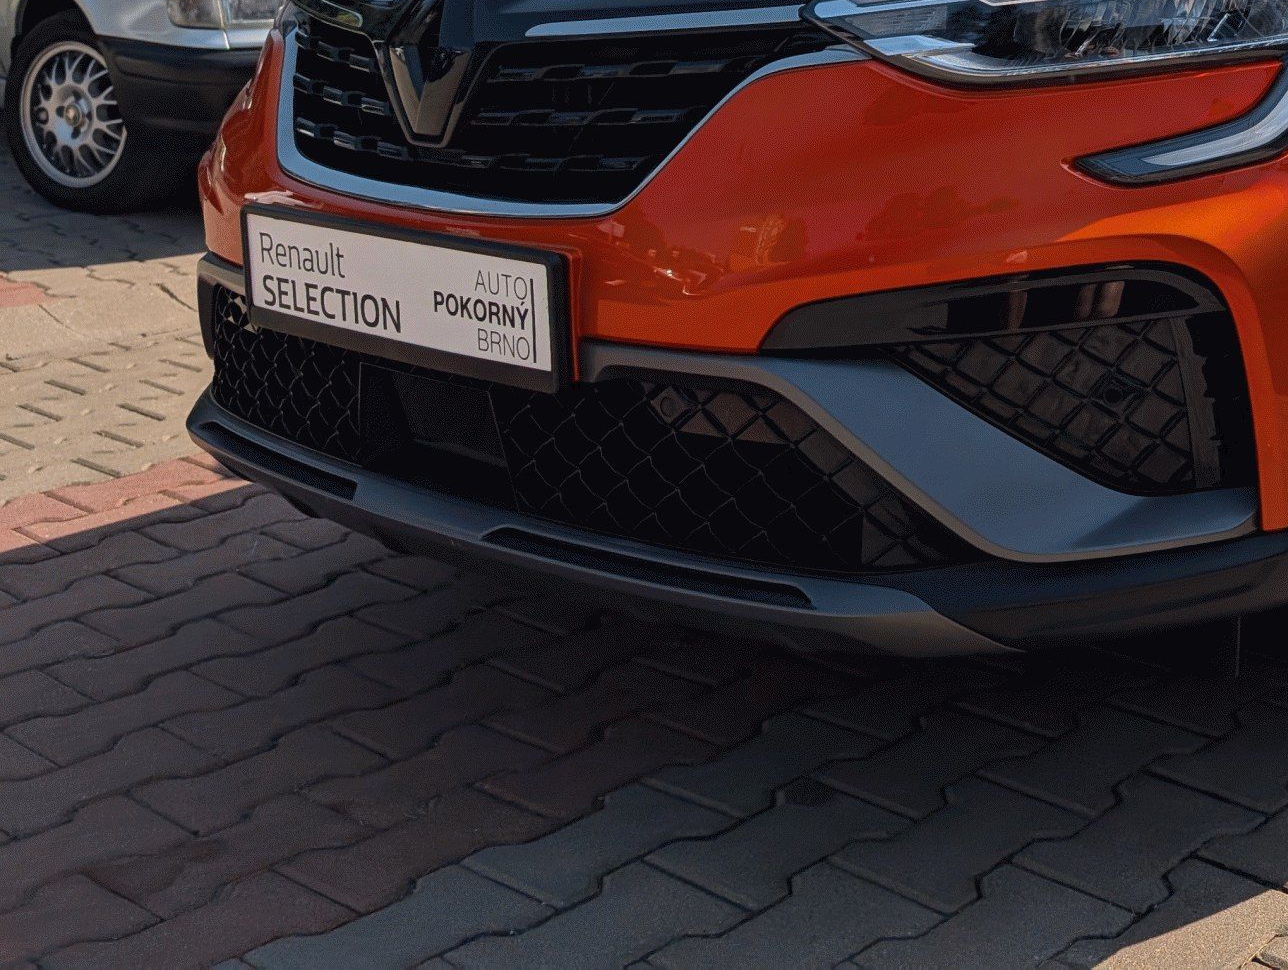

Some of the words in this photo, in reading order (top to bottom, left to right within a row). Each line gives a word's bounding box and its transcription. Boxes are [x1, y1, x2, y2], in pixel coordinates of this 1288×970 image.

[260, 232, 345, 279] Renault
[263, 275, 401, 333] SELECTION
[474, 270, 528, 301] AUTO
[433, 291, 529, 329] POKORNÝ
[477, 328, 530, 361] BRNO
